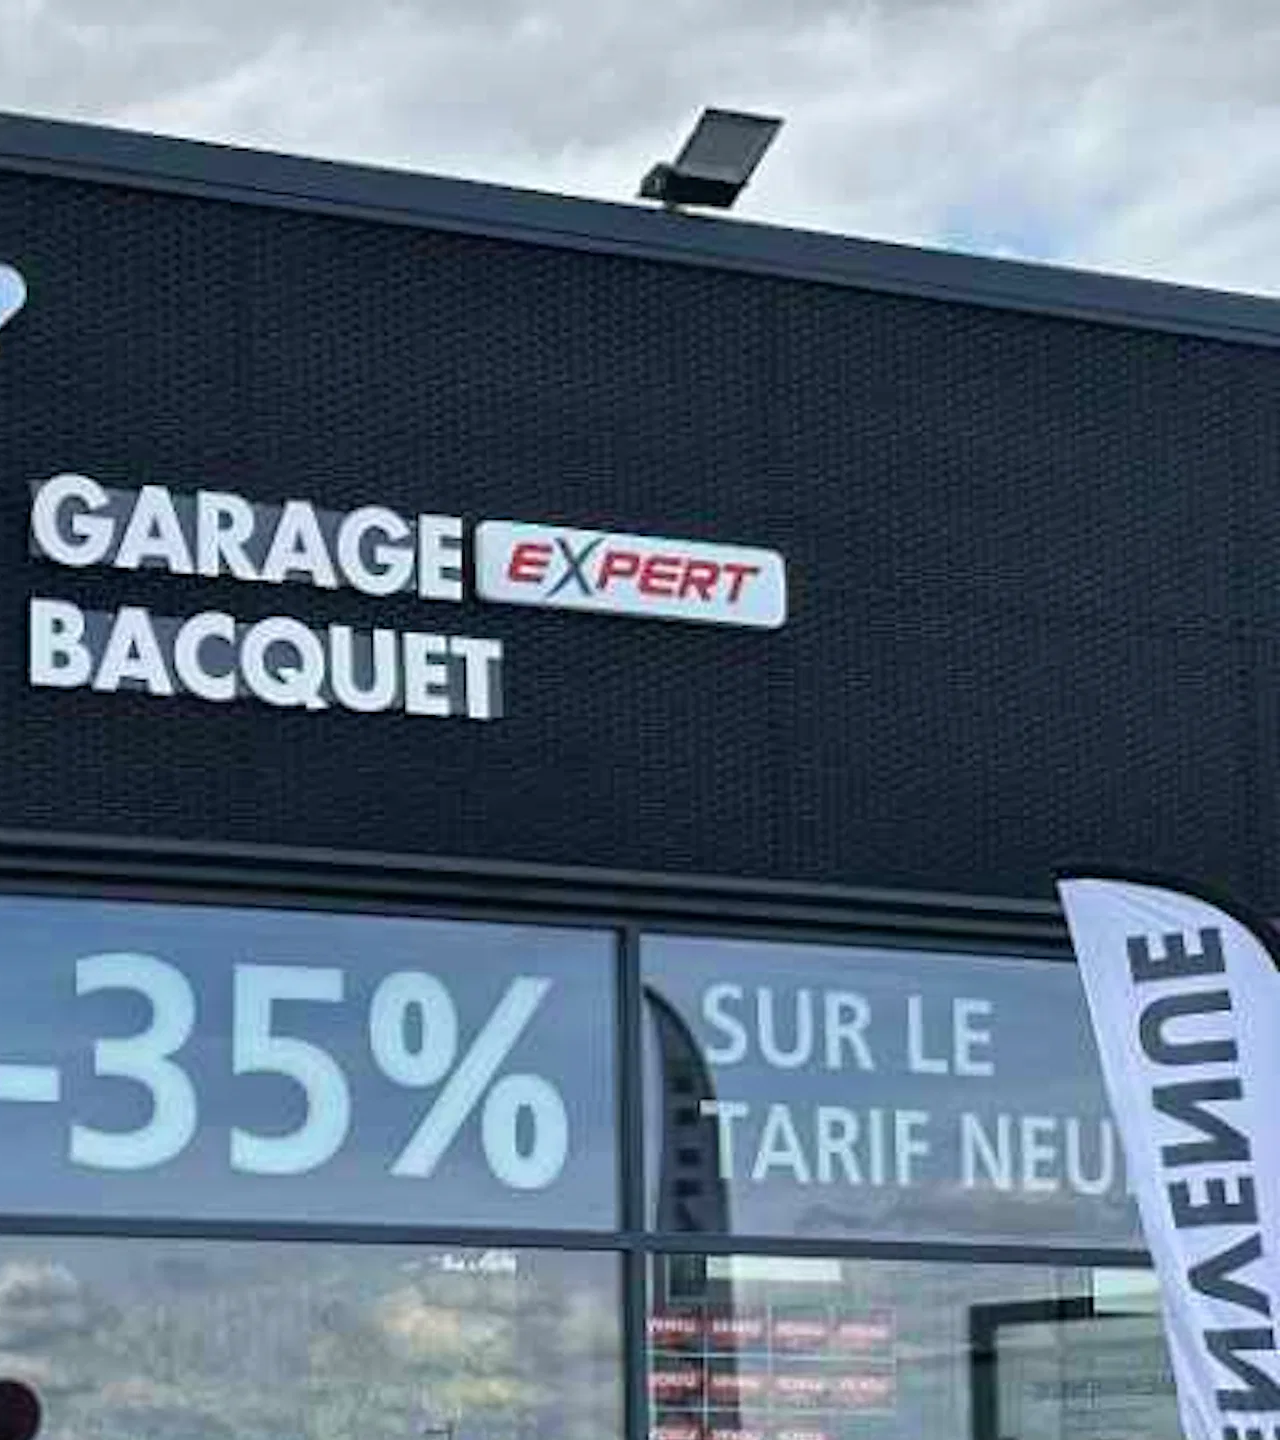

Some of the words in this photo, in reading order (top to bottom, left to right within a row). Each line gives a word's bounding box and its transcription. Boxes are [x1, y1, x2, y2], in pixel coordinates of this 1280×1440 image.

[31, 473, 463, 600] GARAGE
[30, 597, 502, 720] BACQUET
[702, 982, 875, 1071] SUR
[908, 994, 994, 1076] LE
[699, 1099, 931, 1187] TARIF
[961, 1112, 1120, 1195] NEU
